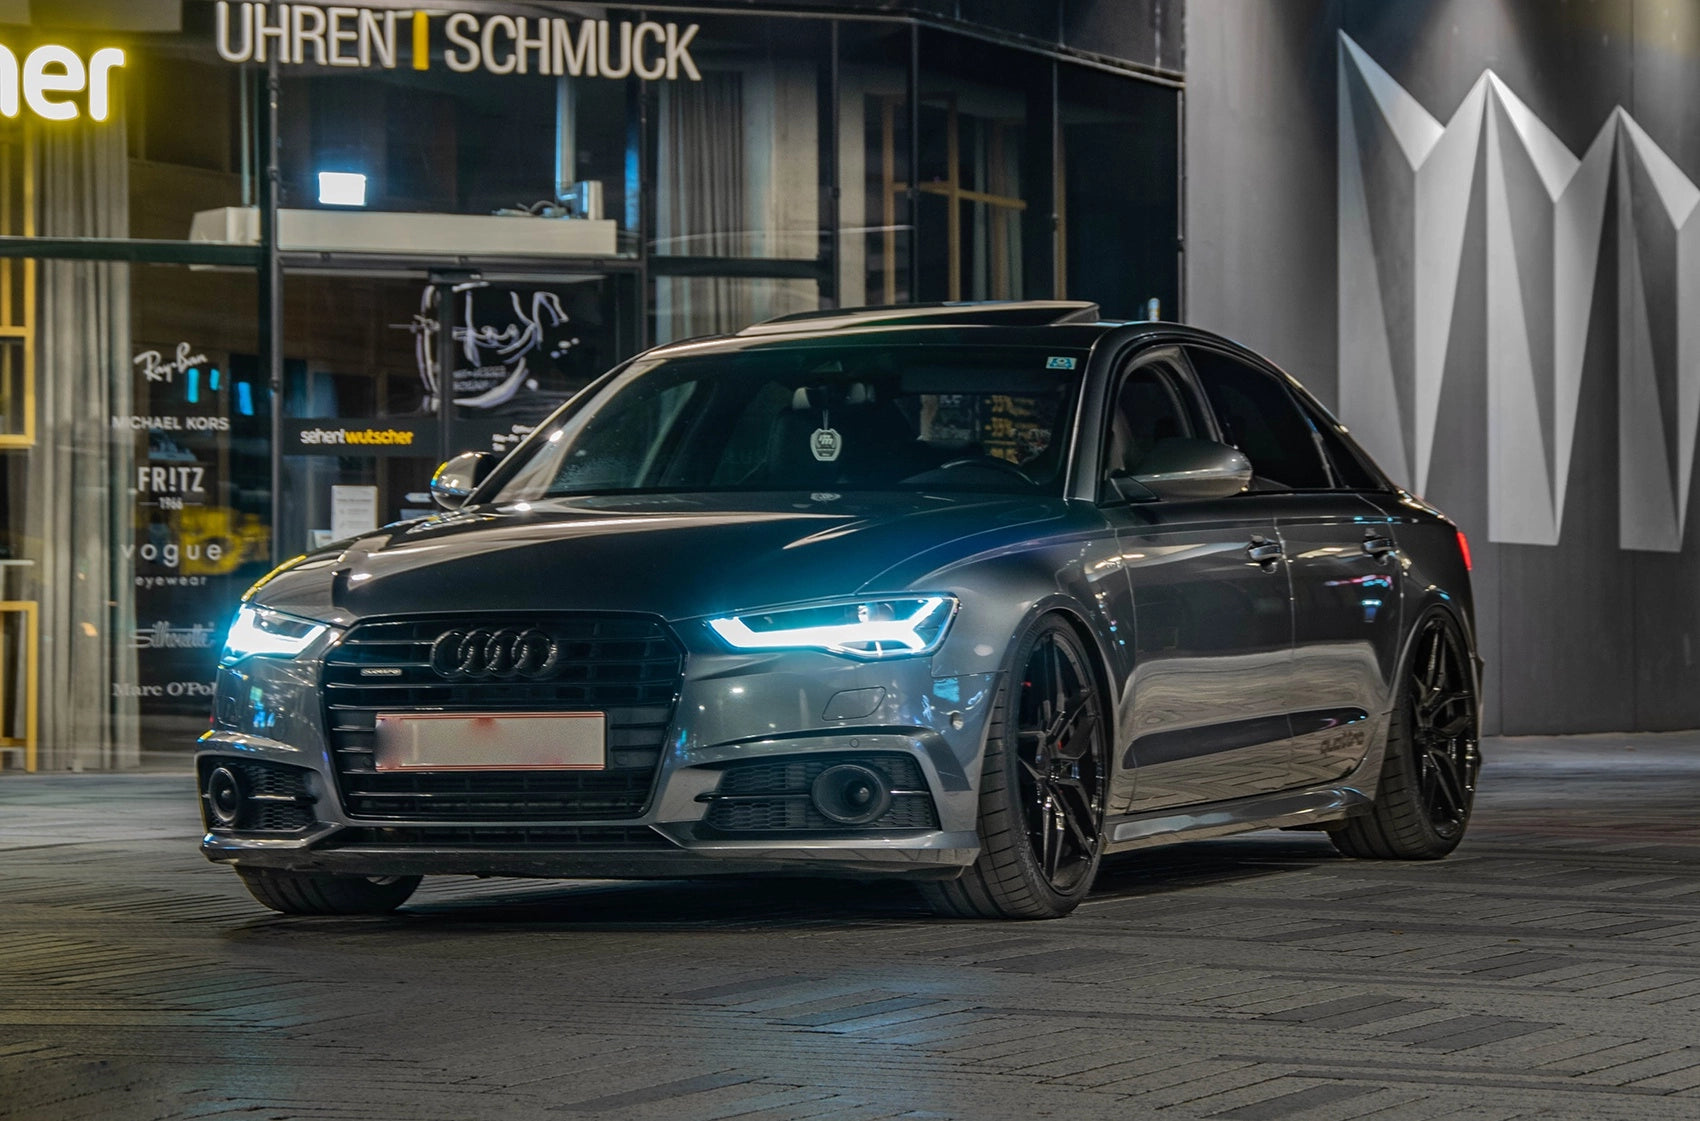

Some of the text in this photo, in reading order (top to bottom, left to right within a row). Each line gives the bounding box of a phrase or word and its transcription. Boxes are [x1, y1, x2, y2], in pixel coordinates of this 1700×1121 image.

[216, 1, 702, 81] UHREN SCHMUCK
[133, 342, 208, 382] Ray-Ban
[111, 415, 230, 430] MICHAEL KORS
[120, 543, 223, 567] vogue
[134, 575, 208, 589] eyewear
[112, 682, 163, 697] Marc
